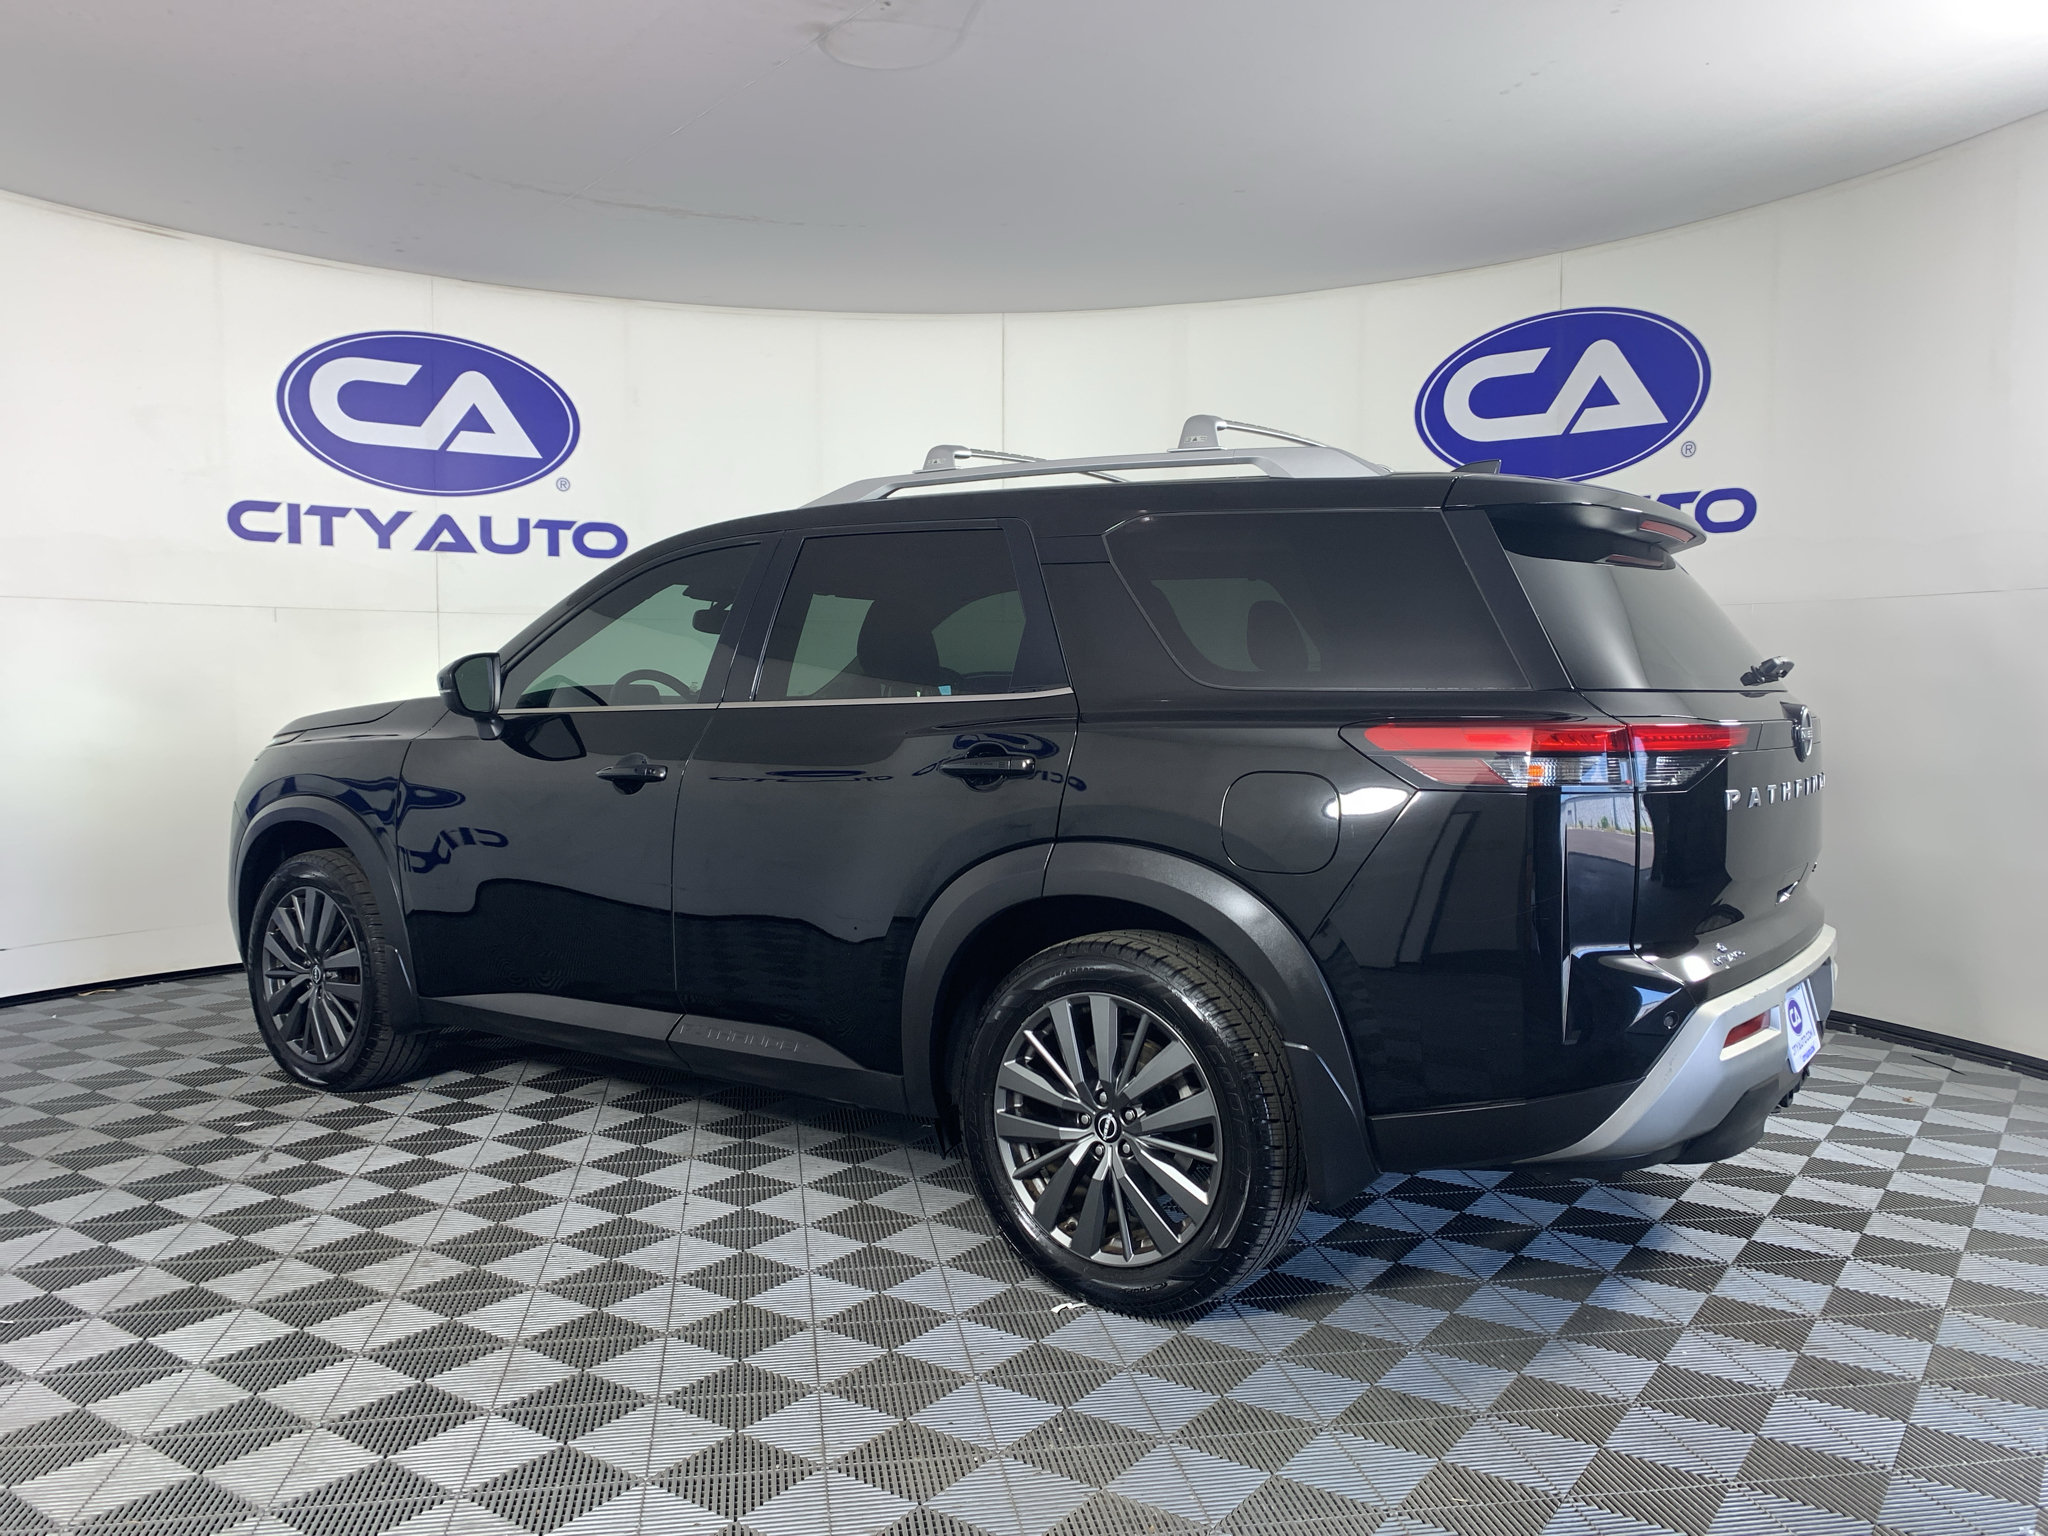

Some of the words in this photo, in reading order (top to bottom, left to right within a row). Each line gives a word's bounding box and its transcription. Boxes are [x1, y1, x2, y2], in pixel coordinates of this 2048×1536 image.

[308, 356, 543, 459] CA
[1443, 338, 1669, 443] CA
[227, 500, 414, 550] CITY
[414, 513, 629, 559] AUTO
[1643, 487, 1757, 533] TO
